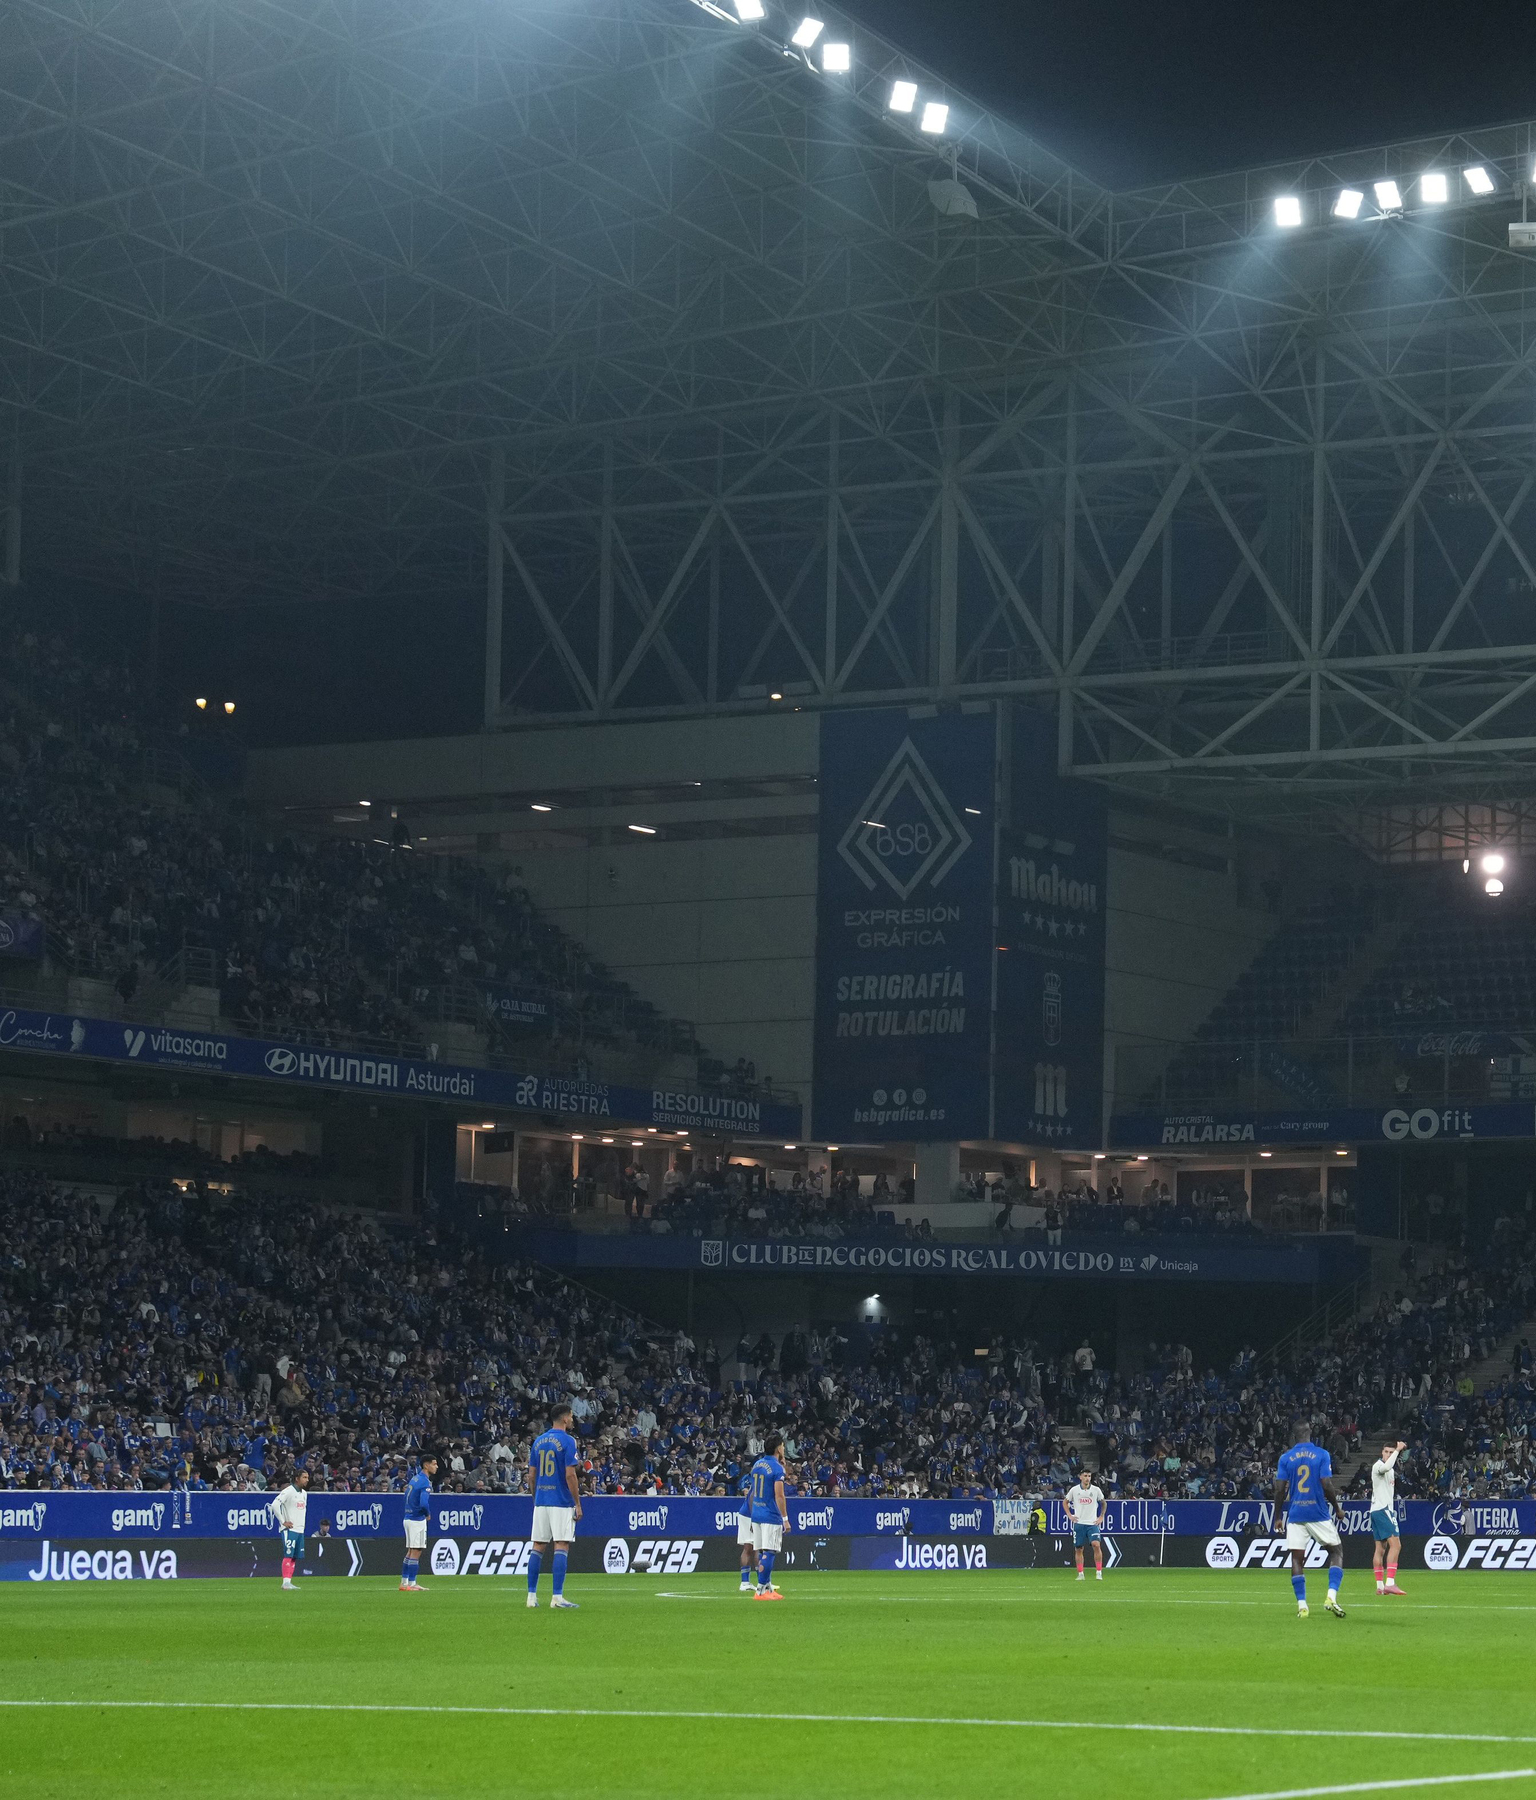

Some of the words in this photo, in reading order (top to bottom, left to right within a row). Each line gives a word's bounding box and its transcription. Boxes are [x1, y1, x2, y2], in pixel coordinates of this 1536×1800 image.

[876, 823, 932, 856] BSB
[1009, 855, 1098, 914] Mahou
[844, 902, 961, 927] EXPRESIÓN
[857, 927, 947, 948] GRÁFICA
[836, 966, 965, 1001] SERIGRAFÍA
[836, 1002, 966, 1037] ROTULACIÓN
[150, 1029, 227, 1060] vitasana
[300, 1053, 399, 1088] HYUNDAI
[406, 1067, 475, 1096] Asturdai
[543, 1078, 609, 1097] AUTORUEDAS
[542, 1090, 611, 1117] RIESTRA
[652, 1090, 760, 1121] RESOLUTION
[854, 1106, 945, 1125] bsbgrafica.es
[652, 1112, 702, 1126] SERVICIOS
[703, 1117, 760, 1133] INTEGRALES
[1161, 1122, 1256, 1143] RALARSA
[1186, 1116, 1214, 1124] CRISTAL
[1302, 1120, 1329, 1132] group
[732, 1243, 798, 1265] CLUB
[815, 1246, 947, 1267] NEGOCIOS
[951, 1249, 1014, 1271] REAL
[1019, 1250, 1114, 1272] OVIEDO
[1120, 1257, 1135, 1268] BY
[1160, 1259, 1199, 1273] Unicaja
[538, 1449, 555, 1477] 16
[753, 1473, 765, 1498] 11
[1297, 1464, 1310, 1493] 2
[435, 1562, 455, 1570] SPORTS
[607, 1560, 625, 1568] SPORTS
